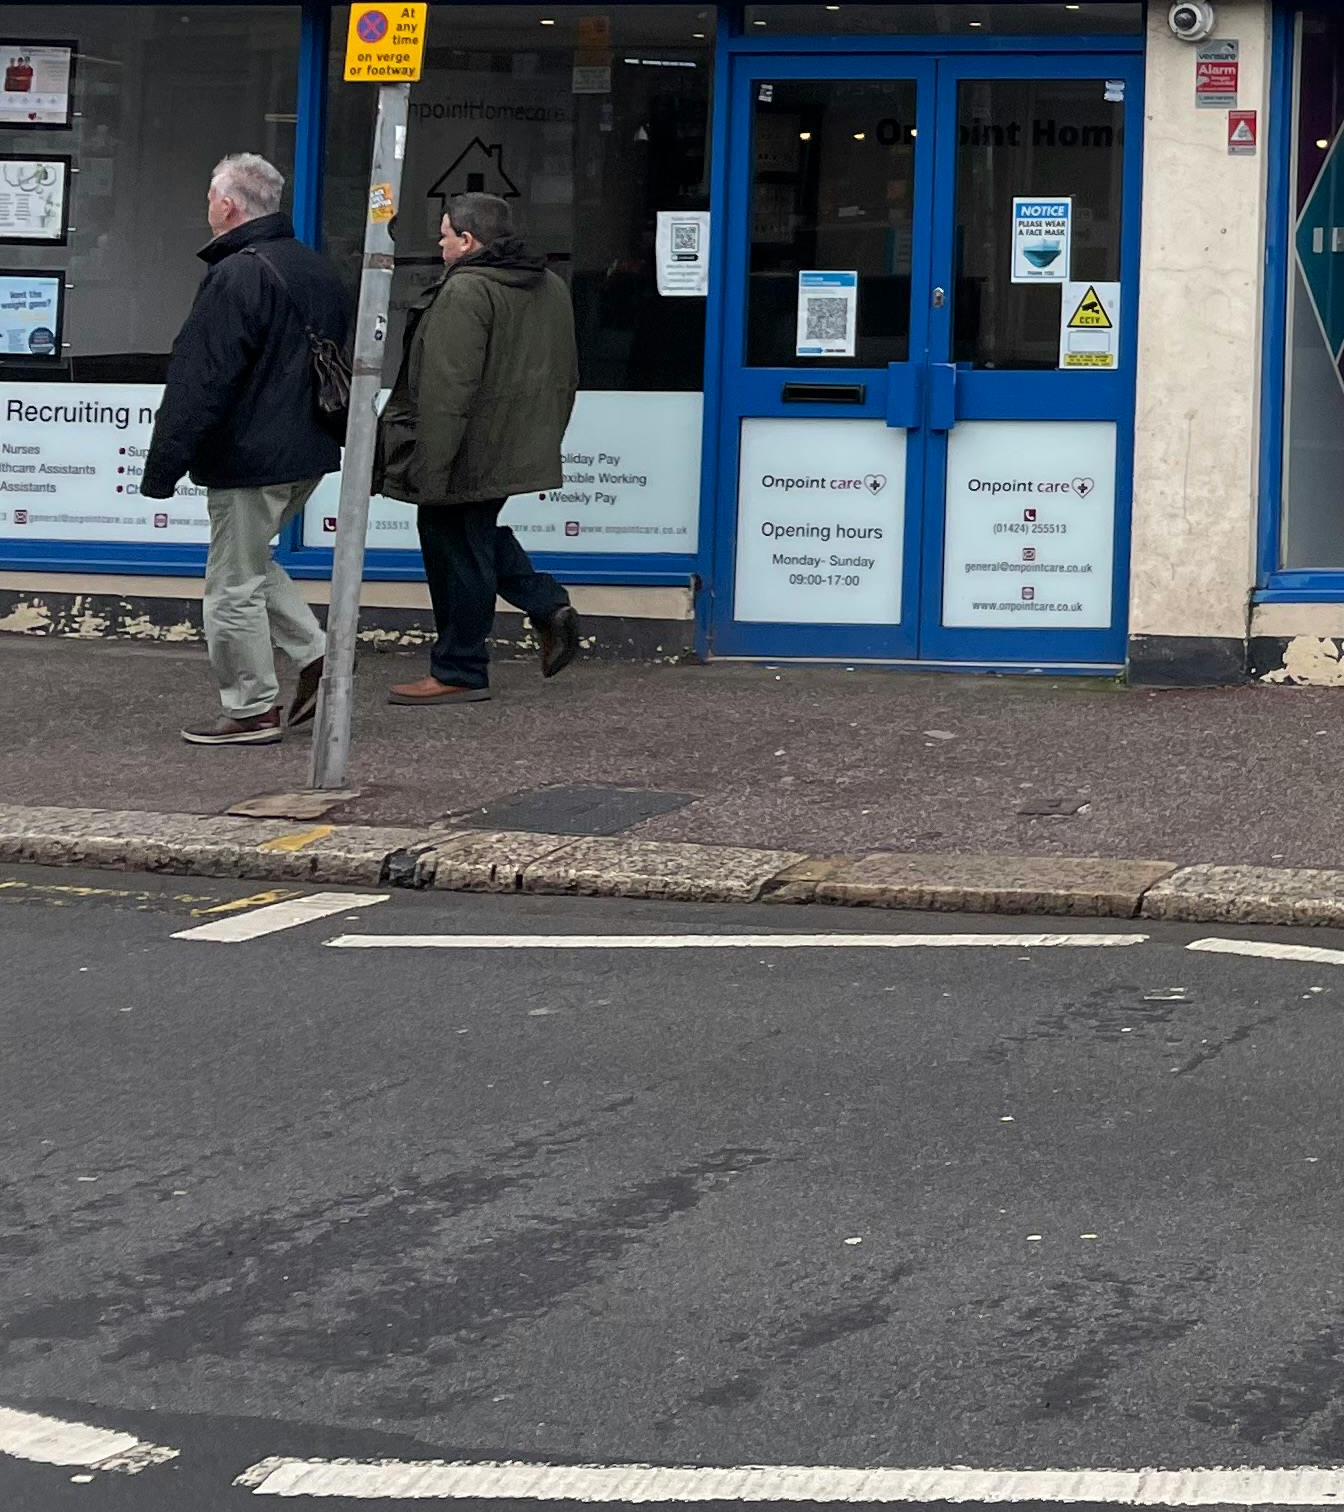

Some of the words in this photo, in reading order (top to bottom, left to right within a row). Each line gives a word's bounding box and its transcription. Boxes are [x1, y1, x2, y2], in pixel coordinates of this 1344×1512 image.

[401, 7, 415, 18] At
[395, 23, 418, 34] any
[392, 34, 419, 45] time
[357, 53, 373, 62] on
[376, 53, 410, 64] verge
[349, 67, 362, 76] or
[366, 64, 416, 78] footway
[1199, 64, 1237, 75] Alarm
[1020, 205, 1065, 217] NOTICE
[1018, 220, 1043, 228] PLEASE
[1044, 220, 1066, 228] WEAR
[1079, 316, 1100, 324] CCTV
[6, 399, 130, 429] Recruiting
[2, 443, 41, 455] Nurses
[561, 453, 595, 467] oliday
[599, 453, 621, 467] Pay
[38, 463, 96, 475] Assistants
[561, 473, 595, 484] exible
[599, 473, 648, 487] Working
[761, 474, 826, 491] Onpoint
[830, 477, 863, 490] care
[0, 481, 57, 493] Assistants
[967, 478, 1033, 495] Onpoint
[1037, 481, 1070, 493] care
[550, 491, 592, 505] Weekly
[594, 492, 617, 506] Pay
[761, 521, 831, 541] Opening
[836, 522, 883, 540] hours
[993, 523, 1029, 535] (01424)
[1031, 523, 1067, 534] 255513
[829, 554, 875, 570] Sunday
[964, 561, 1093, 574] general@onpointcare.co.uk
[788, 573, 860, 587] 09:00-17:00
[972, 600, 1083, 613] www.onpointcare.co.uk
